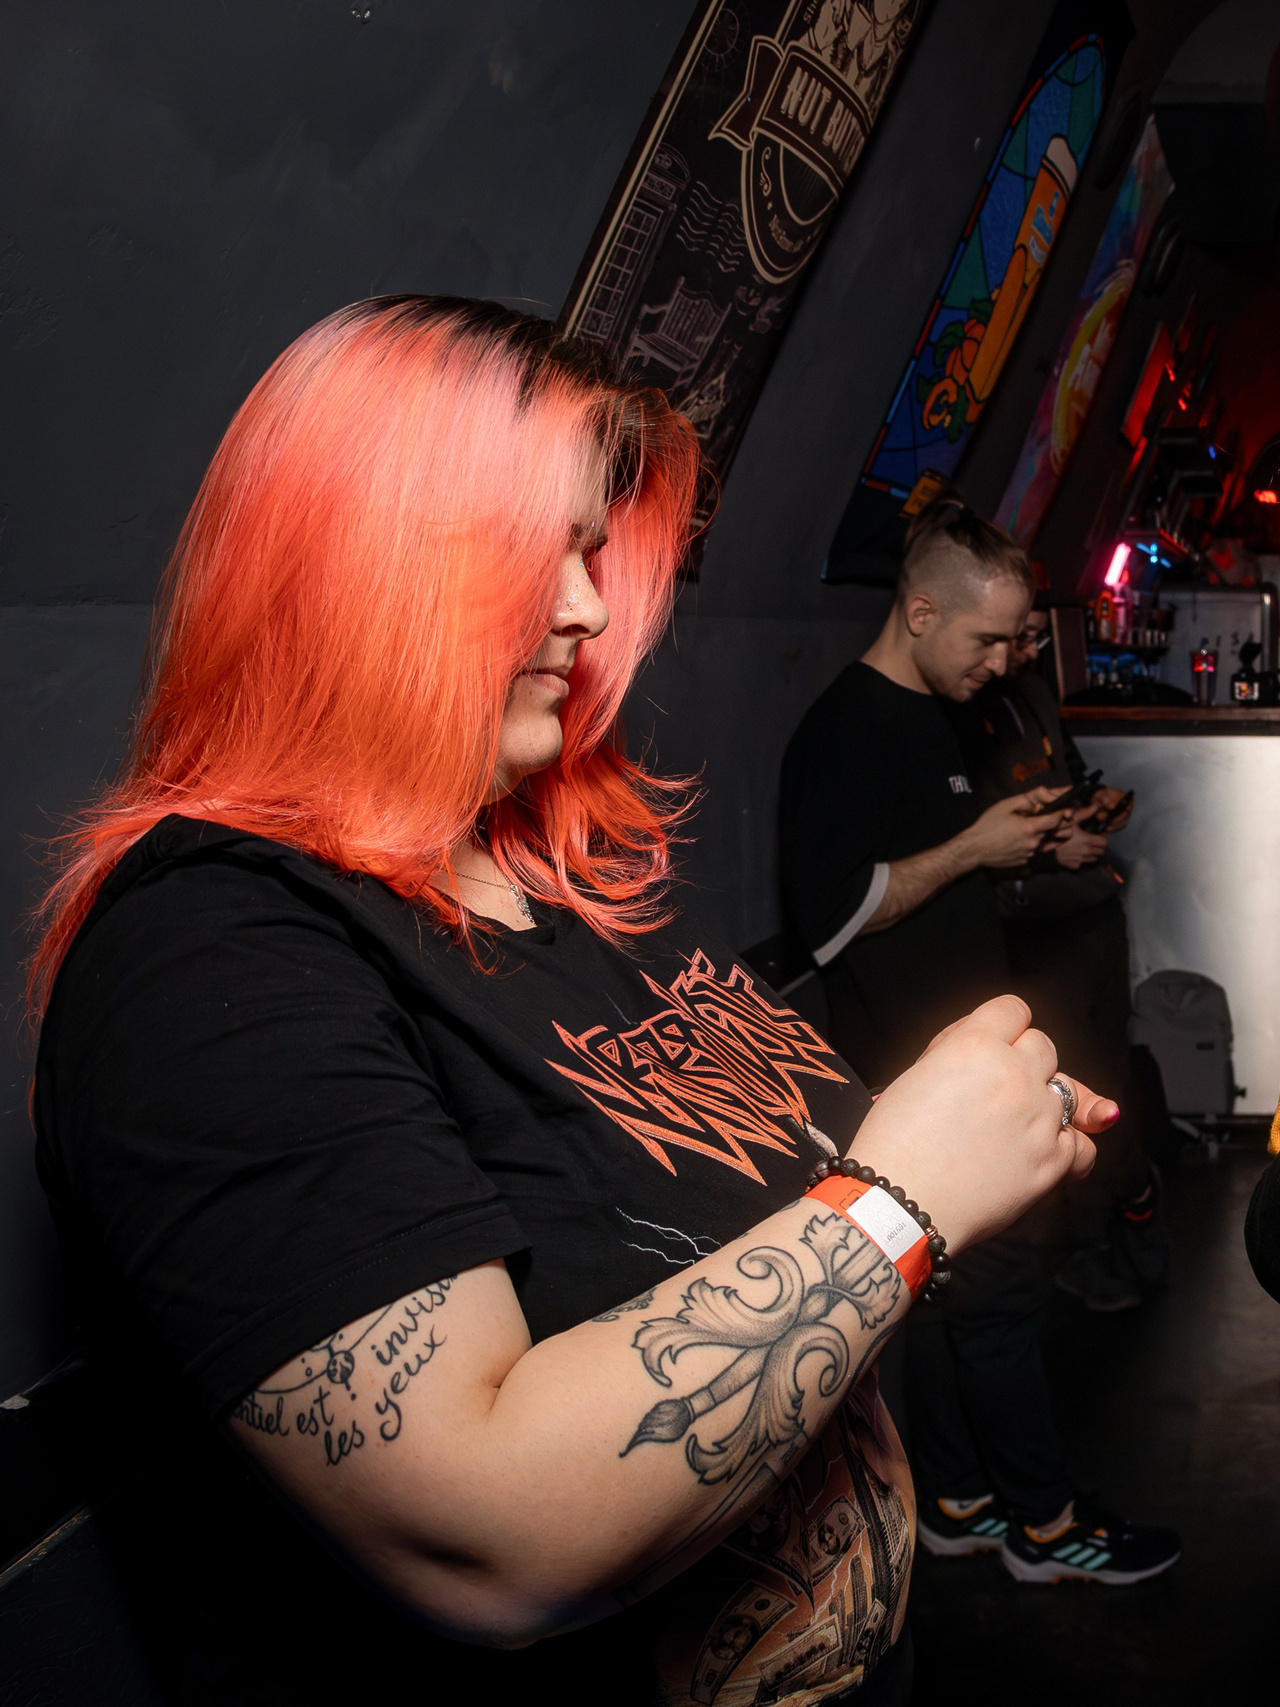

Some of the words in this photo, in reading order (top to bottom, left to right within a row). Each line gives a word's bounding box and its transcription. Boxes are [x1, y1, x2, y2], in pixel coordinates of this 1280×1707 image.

[780, 66, 833, 135] NUT
[296, 1386, 335, 1436] est
[325, 1420, 365, 1467] les
[375, 1325, 448, 1441] yeux
